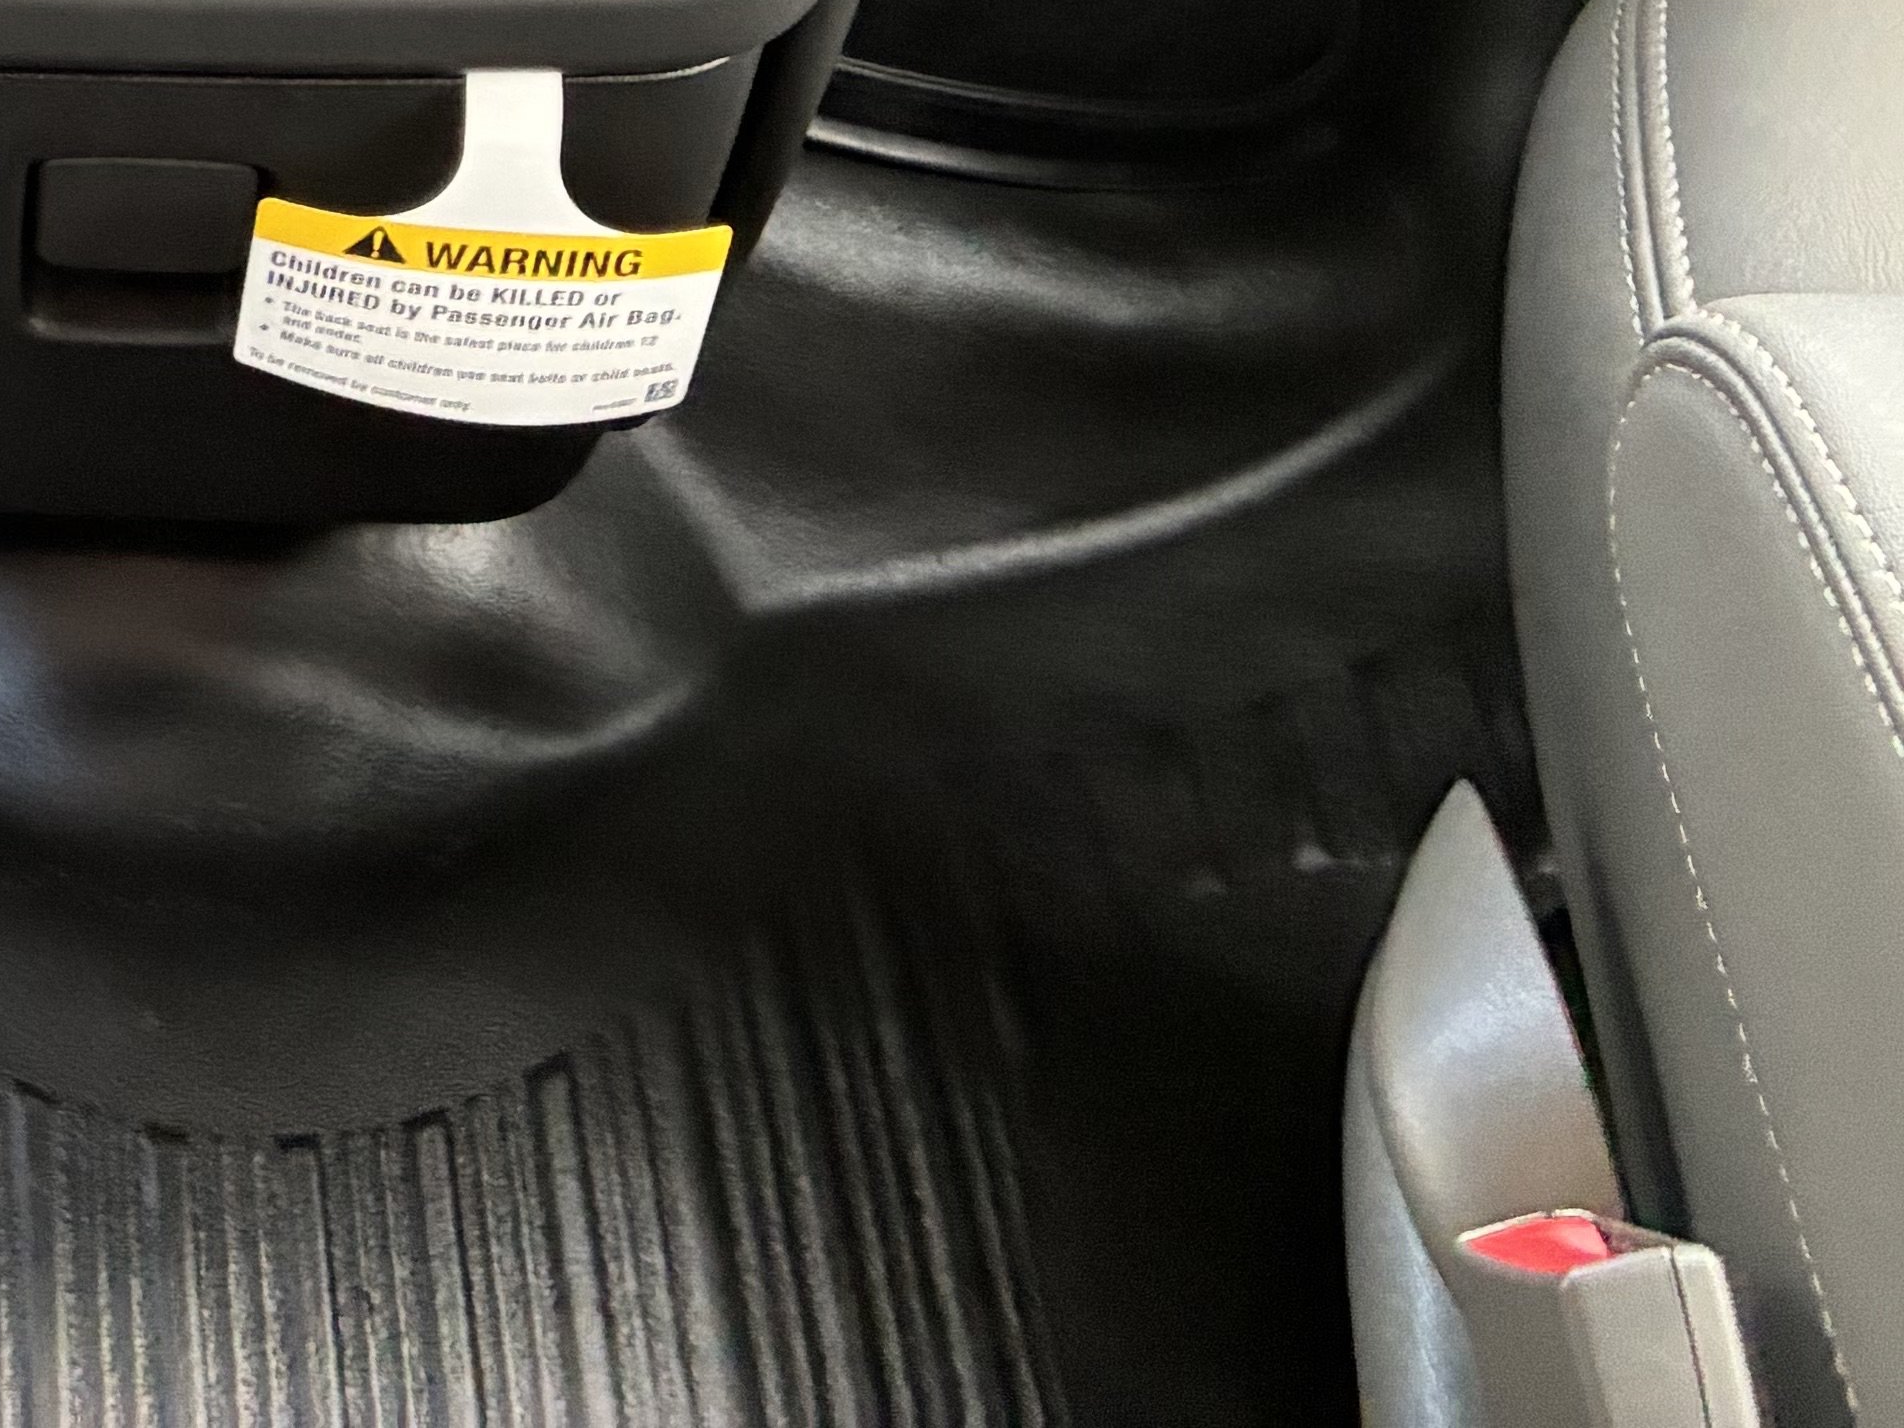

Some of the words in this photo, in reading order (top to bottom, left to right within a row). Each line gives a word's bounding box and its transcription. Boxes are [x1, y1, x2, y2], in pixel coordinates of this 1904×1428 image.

[269, 249, 382, 289] Children
[390, 278, 440, 298] can
[448, 284, 481, 302] be
[491, 287, 585, 307] KILLED
[594, 292, 623, 307] or
[426, 241, 644, 277] WARNING
[267, 270, 381, 311] INJURED
[390, 298, 423, 321] by
[430, 304, 573, 331] Passenger
[578, 312, 619, 329] Air
[626, 309, 681, 326] Bag.
